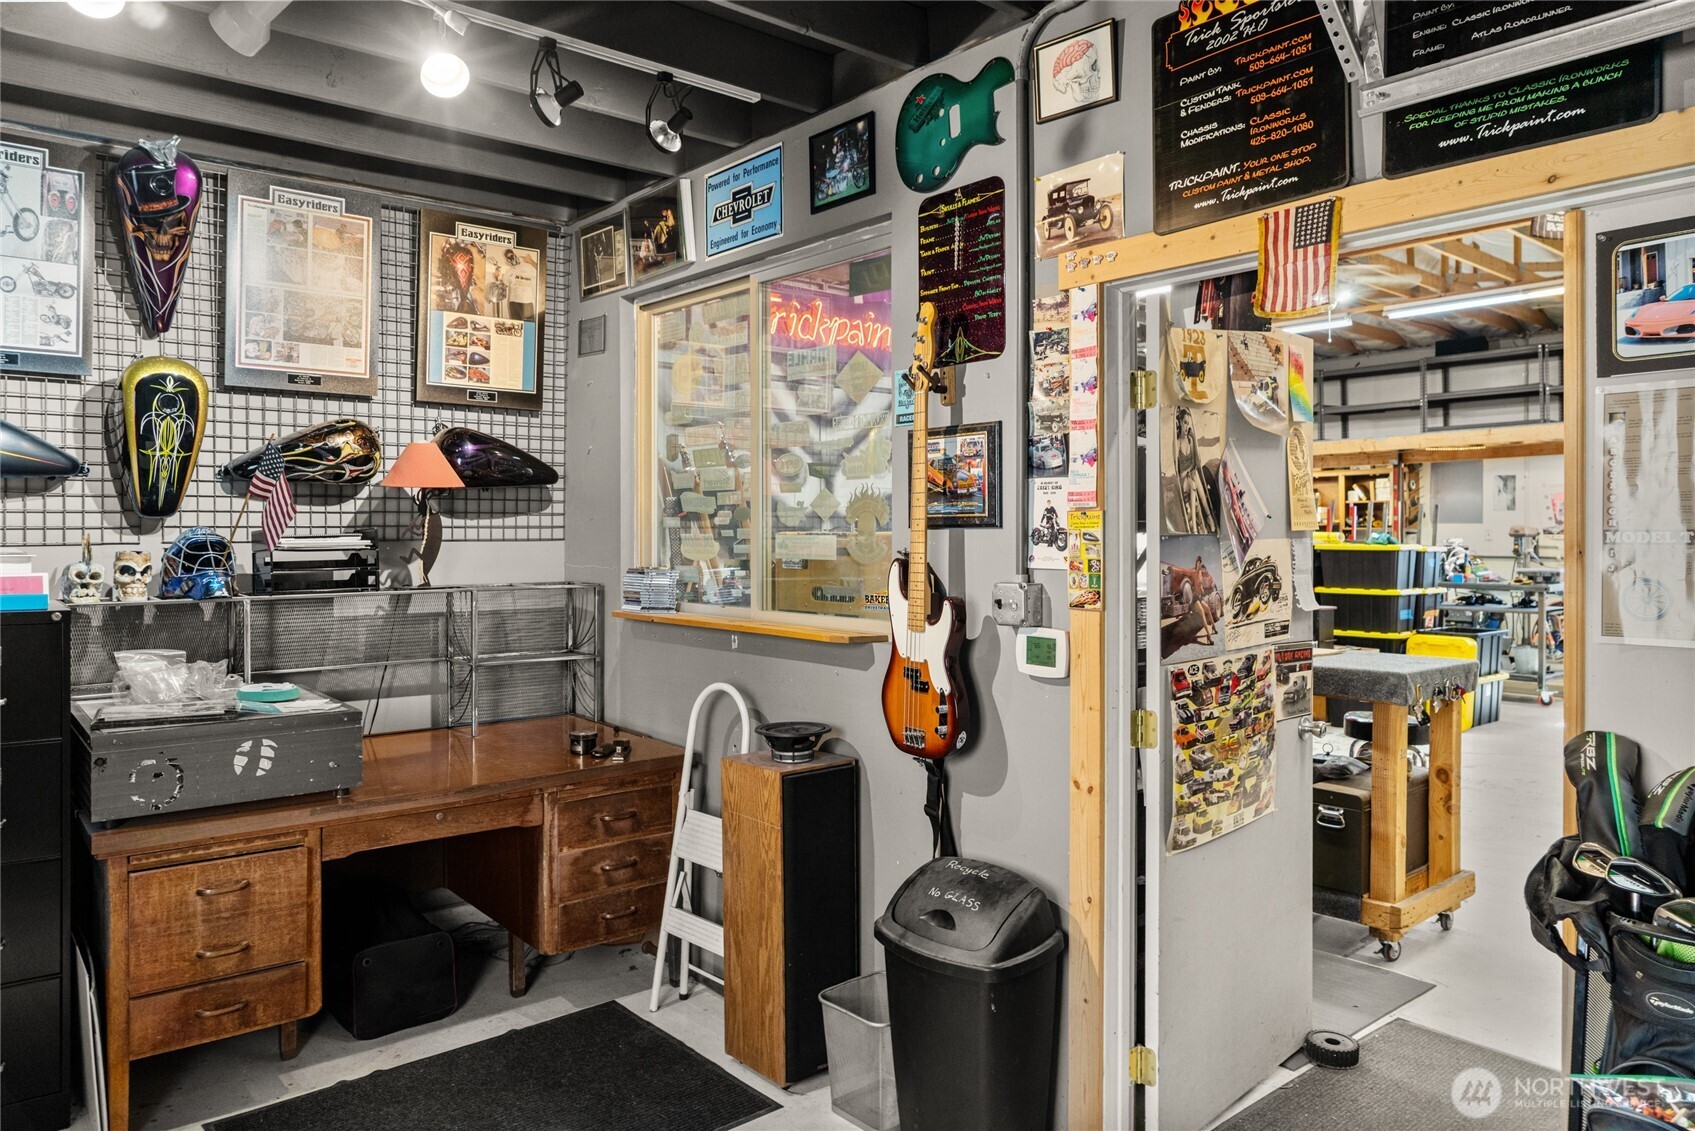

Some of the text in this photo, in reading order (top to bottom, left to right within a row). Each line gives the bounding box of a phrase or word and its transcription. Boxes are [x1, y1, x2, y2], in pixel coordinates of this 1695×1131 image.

[1184, 21, 1222, 47] Trick
[1471, 5, 1574, 41] ATLAS ROADRUNNER
[1205, 30, 1238, 51] 2002
[1249, 43, 1313, 73] 509-664-1051
[1180, 81, 1242, 108] CUSTOM TANK
[1250, 76, 1314, 105] 509-664-1051
[1404, 58, 1630, 124] SPECIAL THANKS TO CLASSIC IRONWORKS
[1409, 69, 1623, 131] FOR KEEPING ME FROM MAKING A BUNCH
[1249, 107, 1292, 126] CLASSIC
[1249, 112, 1307, 136] IRONWORKS
[1454, 117, 1469, 129] OF
[1469, 108, 1508, 127] STUPID
[1180, 122, 1218, 140] CHASSIS
[1250, 119, 1315, 146] 425-820-1080
[1243, 157, 1269, 171] YOUR
[1270, 150, 1290, 163] ONE
[1290, 142, 1318, 157] STOP
[707, 156, 779, 193] Powered for Performance
[1182, 183, 1216, 198] CUSTOM
[1217, 175, 1242, 189] PAINT
[1251, 163, 1282, 179] METAL
[277, 193, 339, 214] Easyriders
[715, 189, 770, 221] CHEVROLET
[461, 227, 513, 245] Easyriders
[710, 220, 778, 251] Engineered for Economy
[1181, 328, 1207, 345] 1923
[1604, 530, 1695, 544] MODEL T
[1580, 732, 1597, 771] RBZ
[945, 859, 990, 880] Recycle
[944, 890, 981, 912] GLASS
